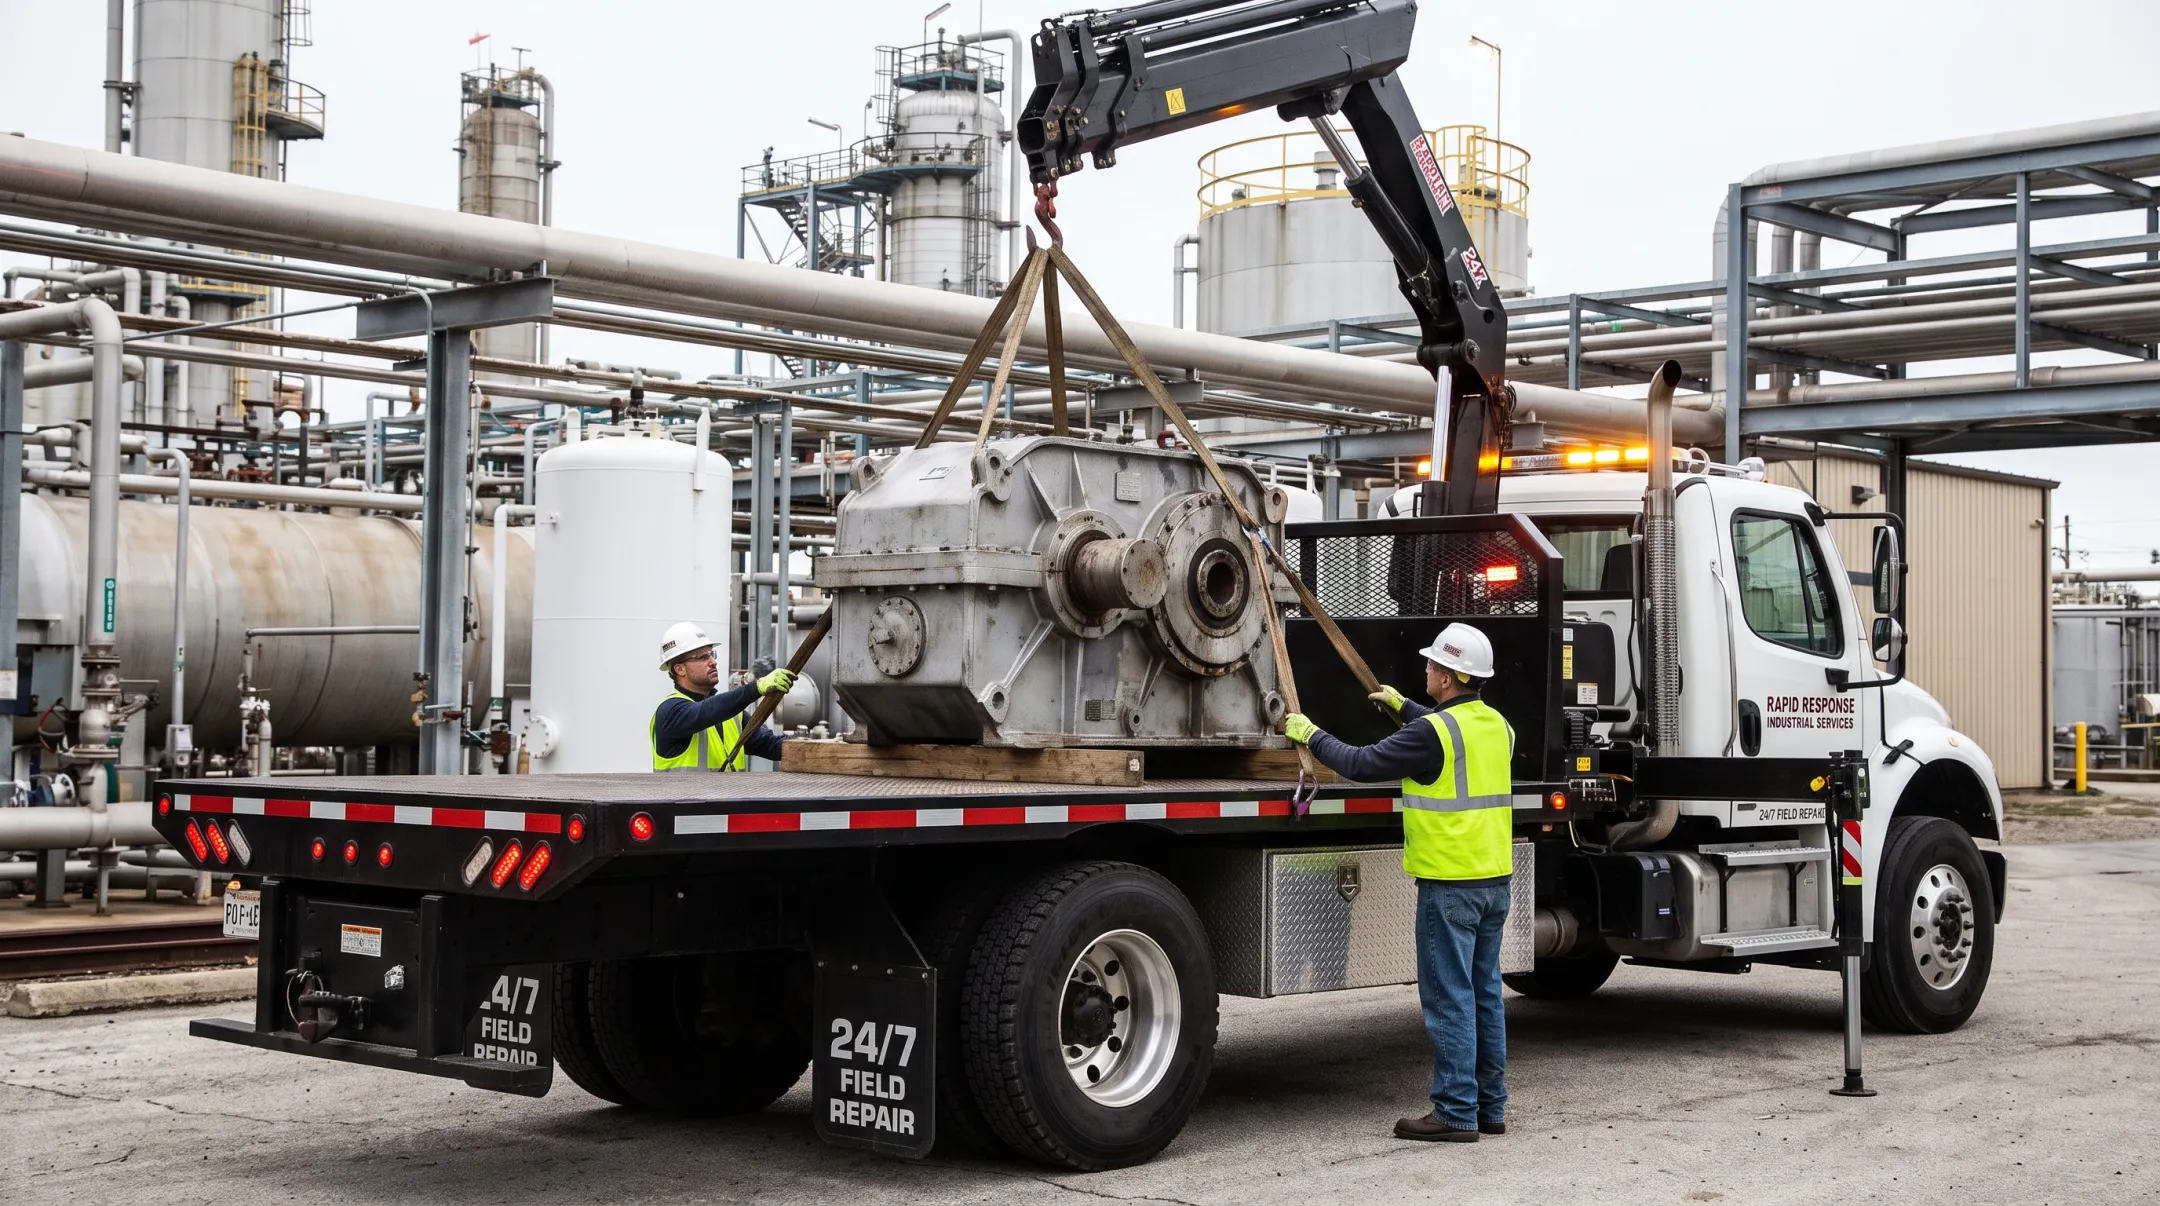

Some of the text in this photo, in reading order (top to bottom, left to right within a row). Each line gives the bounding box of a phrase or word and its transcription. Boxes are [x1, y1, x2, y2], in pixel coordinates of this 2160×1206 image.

[1767, 696, 1855, 714] RAPID RESPONSE
[1767, 716, 1854, 729] INDUSTRIAL SERVICES
[1759, 809, 1776, 821] 24/7
[1777, 808, 1798, 820] FIELD
[481, 1016, 532, 1044] FIELD
[830, 1017, 917, 1067] 24/7
[840, 1067, 906, 1101] FIELD
[829, 1097, 915, 1136] REPAIR
